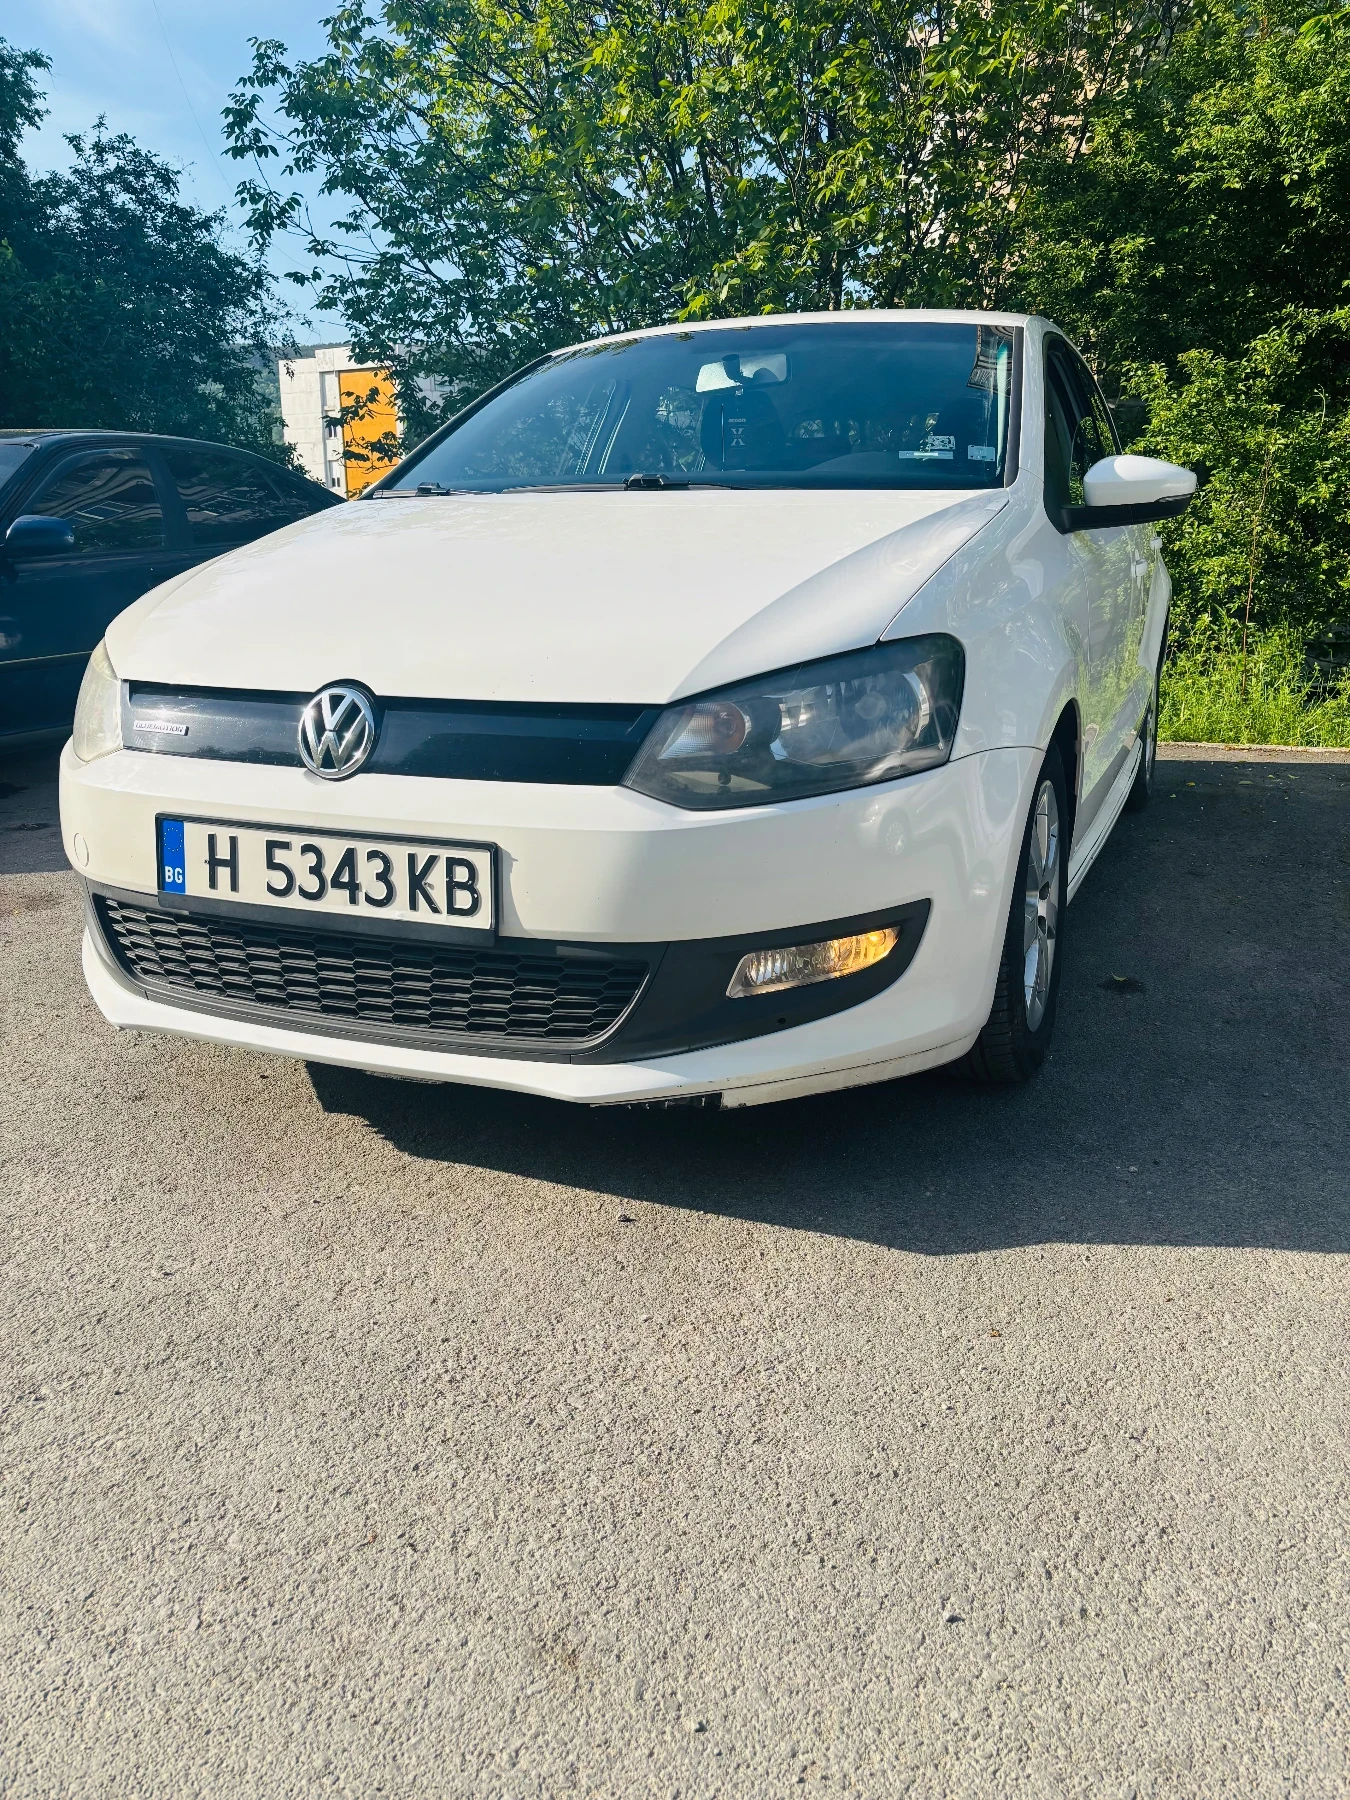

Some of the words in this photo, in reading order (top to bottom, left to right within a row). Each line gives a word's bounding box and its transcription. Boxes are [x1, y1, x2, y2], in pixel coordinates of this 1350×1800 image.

[164, 866, 184, 884] BG
[207, 833, 238, 892] H
[265, 839, 394, 908] 5343
[407, 852, 480, 917] KB
